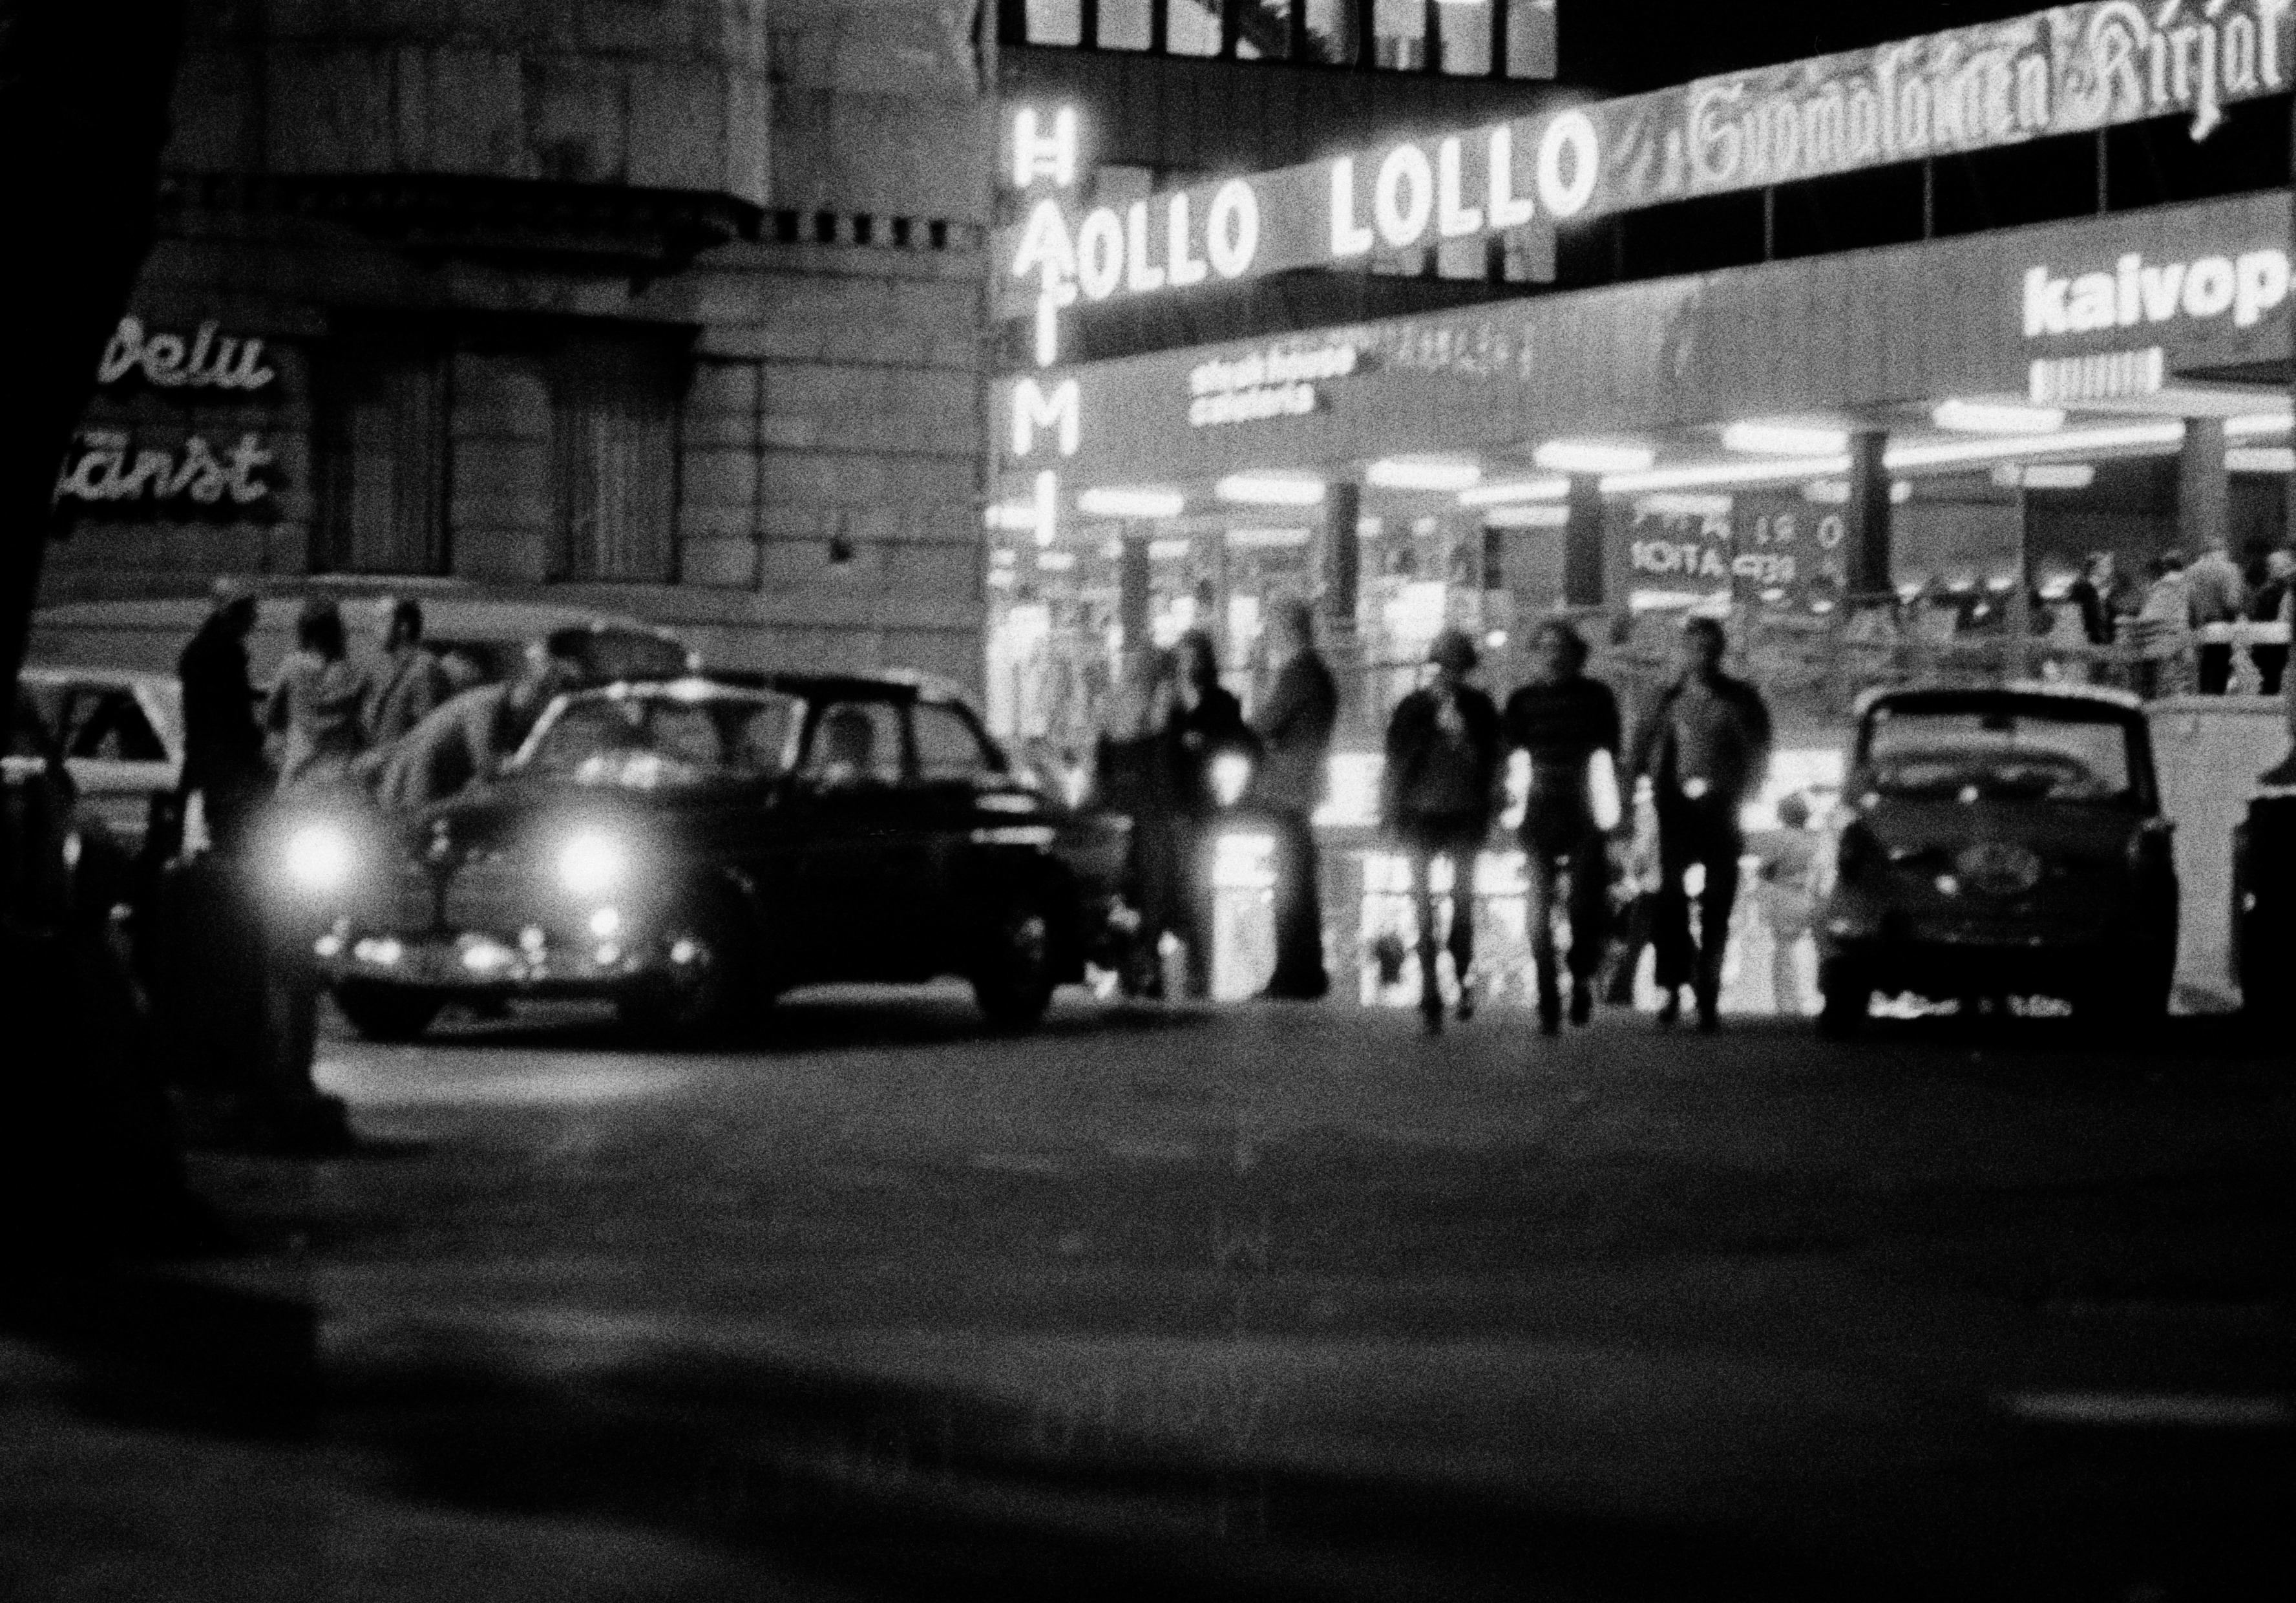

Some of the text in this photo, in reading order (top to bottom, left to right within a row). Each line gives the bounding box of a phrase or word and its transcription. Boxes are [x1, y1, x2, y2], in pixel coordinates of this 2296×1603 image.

[1331, 108, 1598, 257] LOLLO
[1012, 106, 1081, 547] HAIMI
[2023, 249, 2291, 337] kaivop
[54, 429, 273, 504] änst
